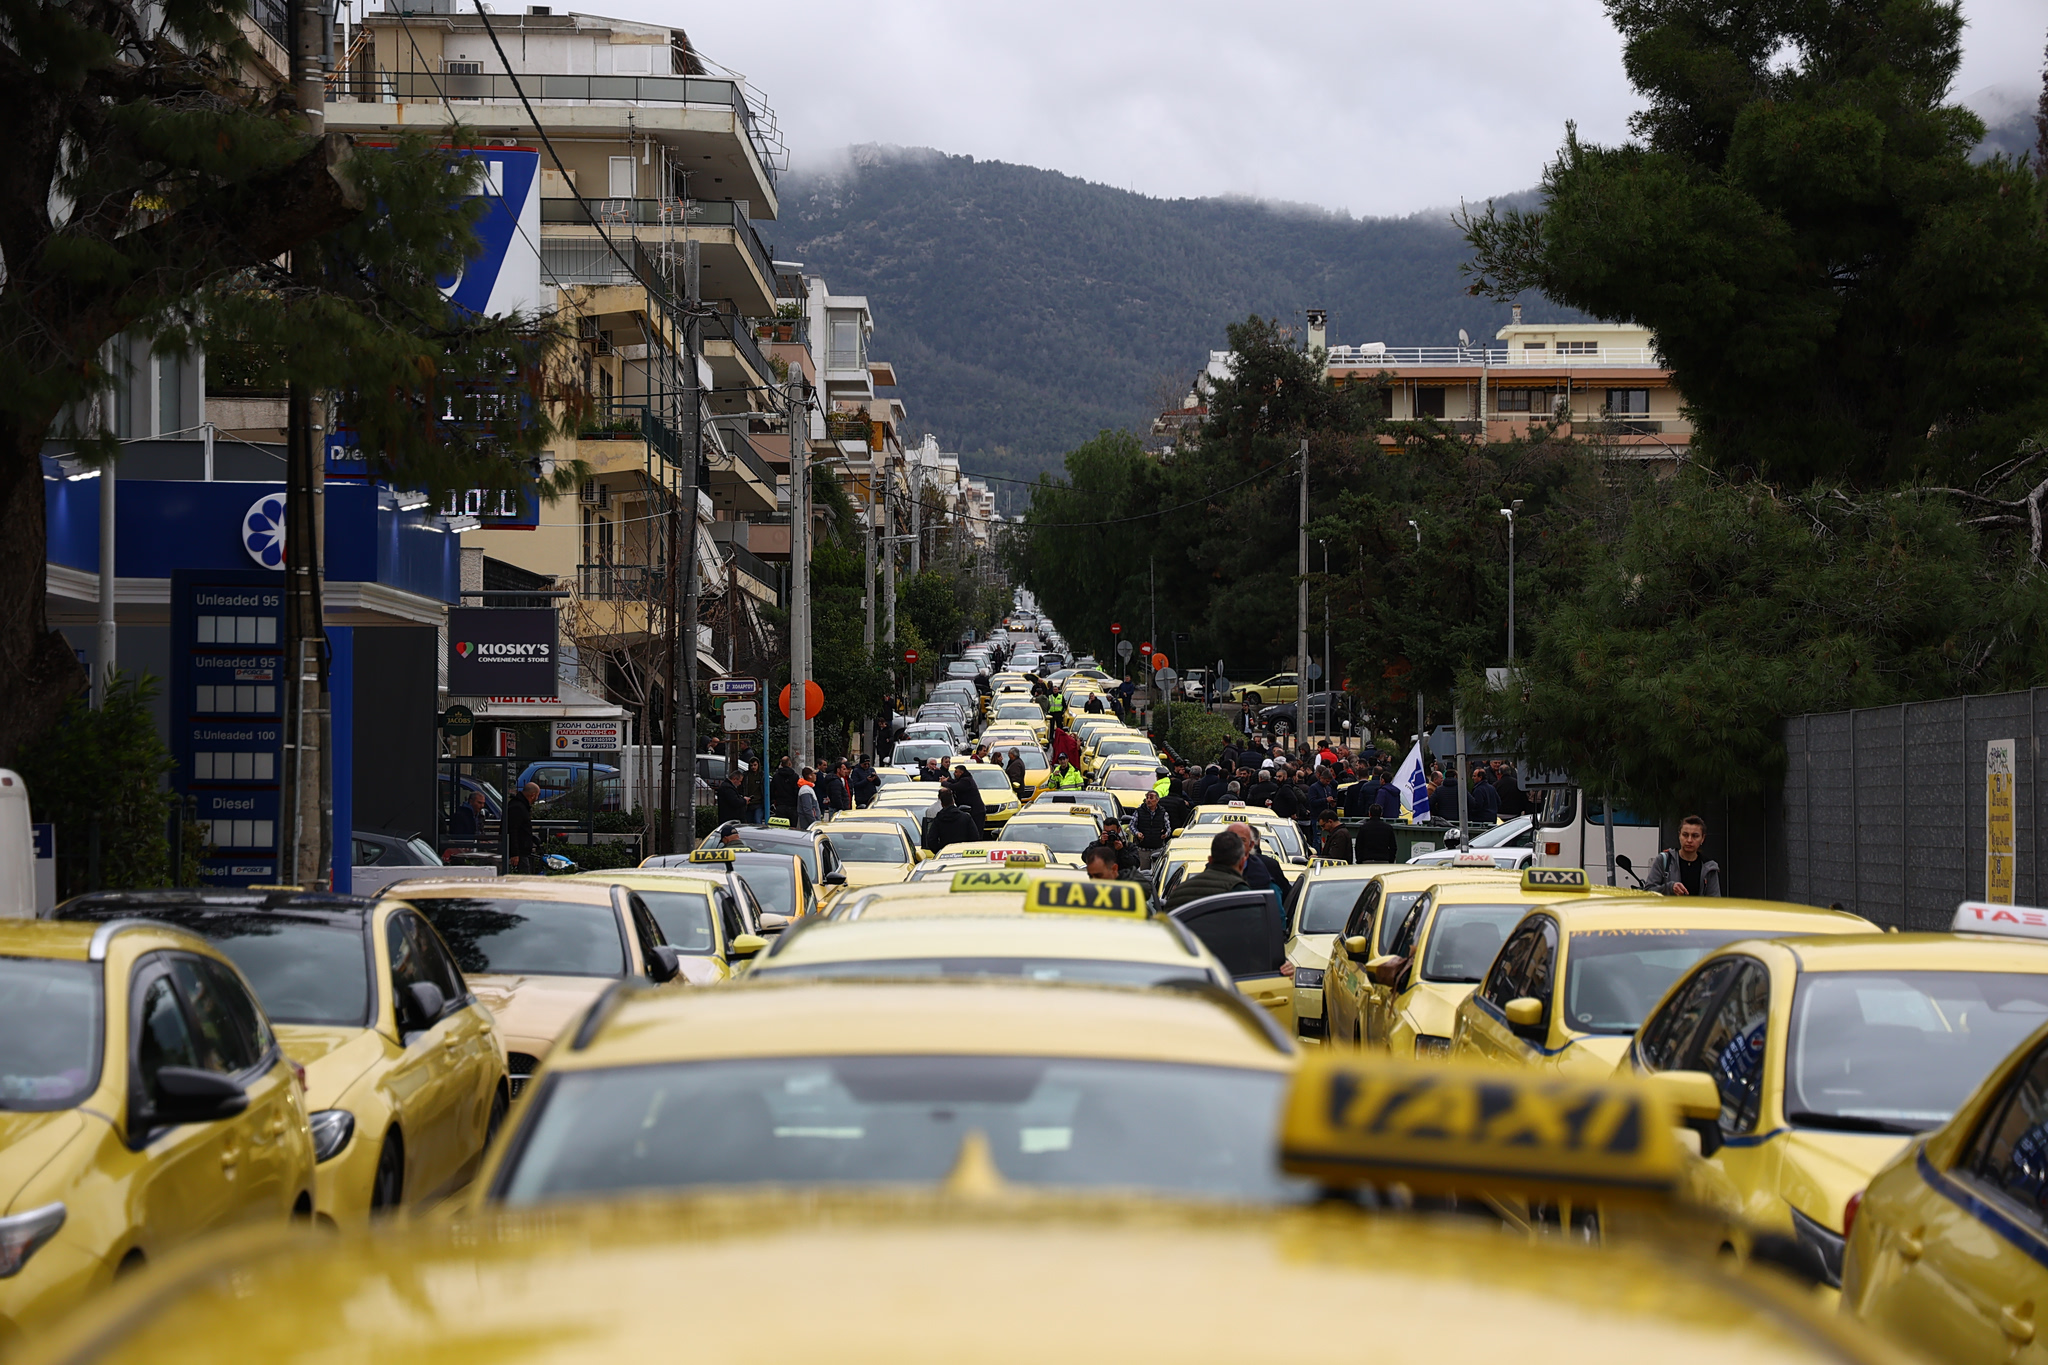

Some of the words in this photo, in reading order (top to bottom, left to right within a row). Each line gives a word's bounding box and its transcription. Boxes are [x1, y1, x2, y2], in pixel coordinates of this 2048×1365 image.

[196, 593, 259, 606] Unleaded
[262, 595, 279, 607] 95
[477, 643, 550, 656] KIOSKY'S
[195, 657, 256, 668] Unleaded
[260, 657, 276, 668] 95
[193, 730, 253, 741] S.Unleaded
[257, 731, 276, 741] 100
[212, 797, 255, 810] Diesel
[1225, 815, 1247, 823] TAXI
[697, 851, 728, 860] TAXI
[1459, 854, 1490, 862] TAXI
[961, 872, 1024, 885] TAXI
[1531, 871, 1582, 884] TAXI
[1044, 882, 1131, 909] TAXI
[1967, 906, 2048, 927] ΤΑΞ
